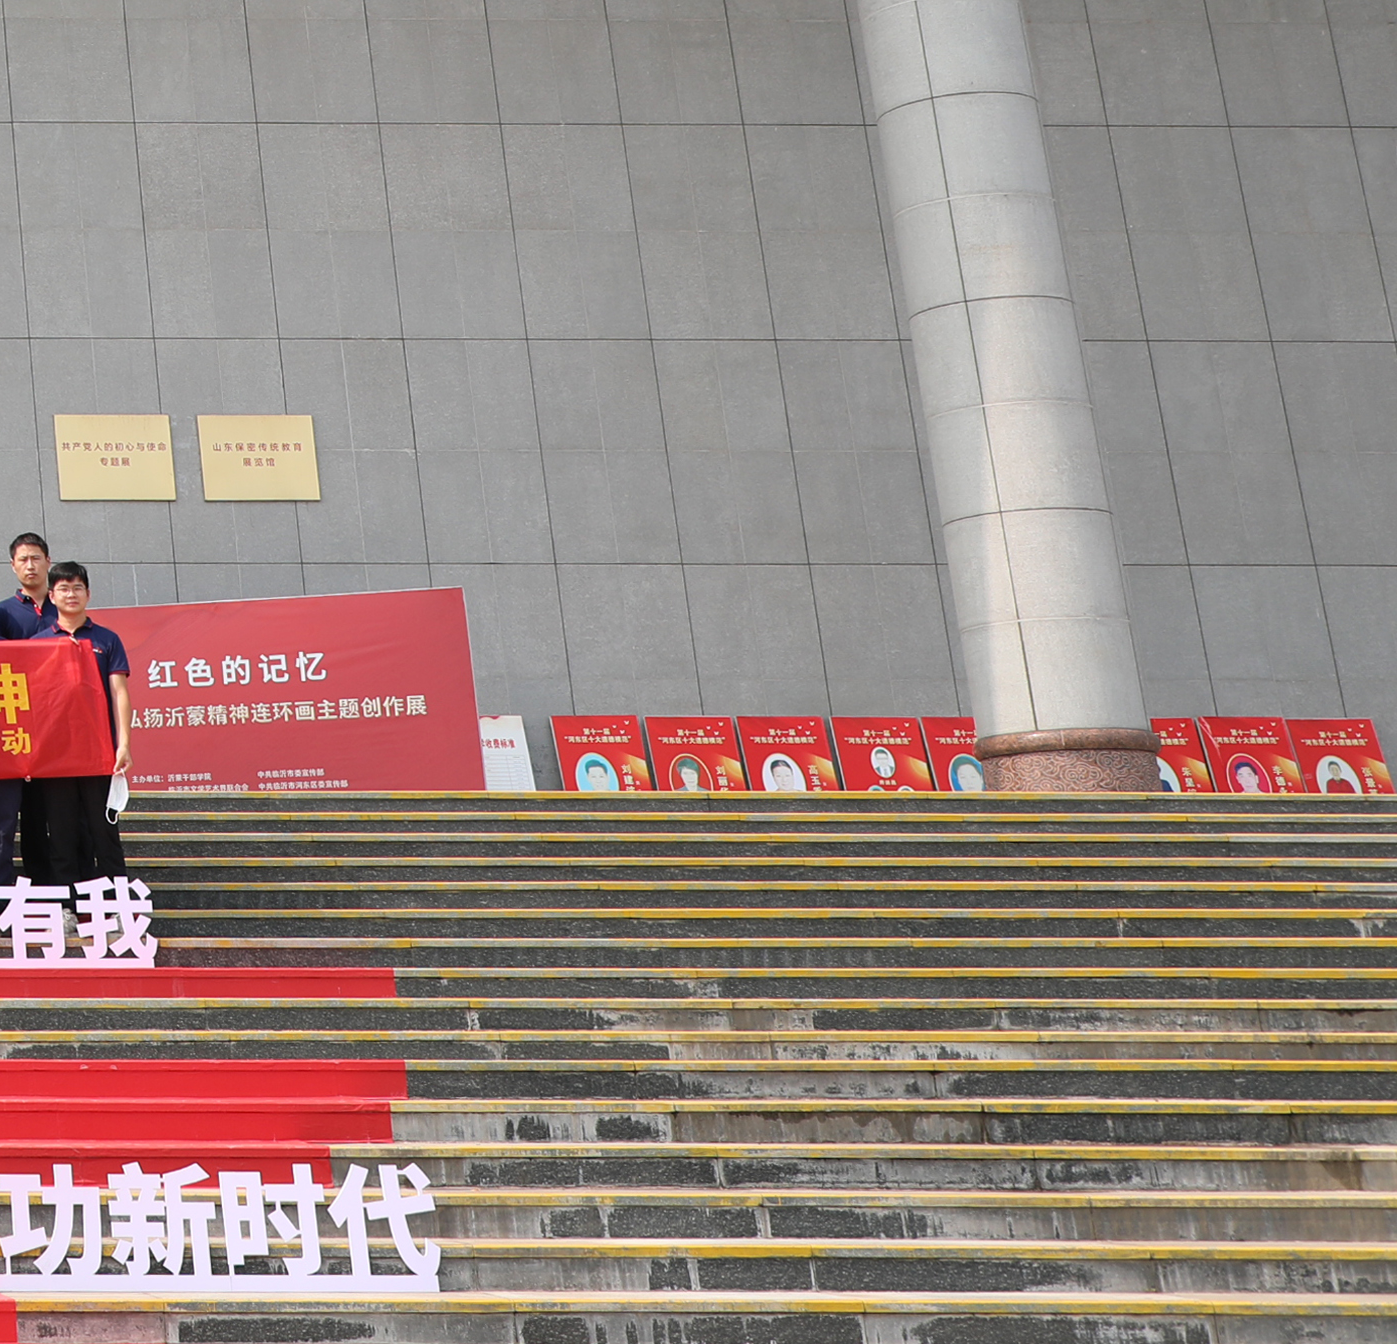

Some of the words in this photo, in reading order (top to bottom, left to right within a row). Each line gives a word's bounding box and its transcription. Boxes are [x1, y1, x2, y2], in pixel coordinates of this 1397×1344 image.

[61, 442, 167, 452] 共产党人的初心与使命
[212, 442, 303, 452] 山东保密传统教育
[99, 457, 131, 467] 专题展
[242, 457, 276, 467] 展览馆
[147, 651, 327, 689] 红色的记忆
[862, 729, 891, 737] 第十一届
